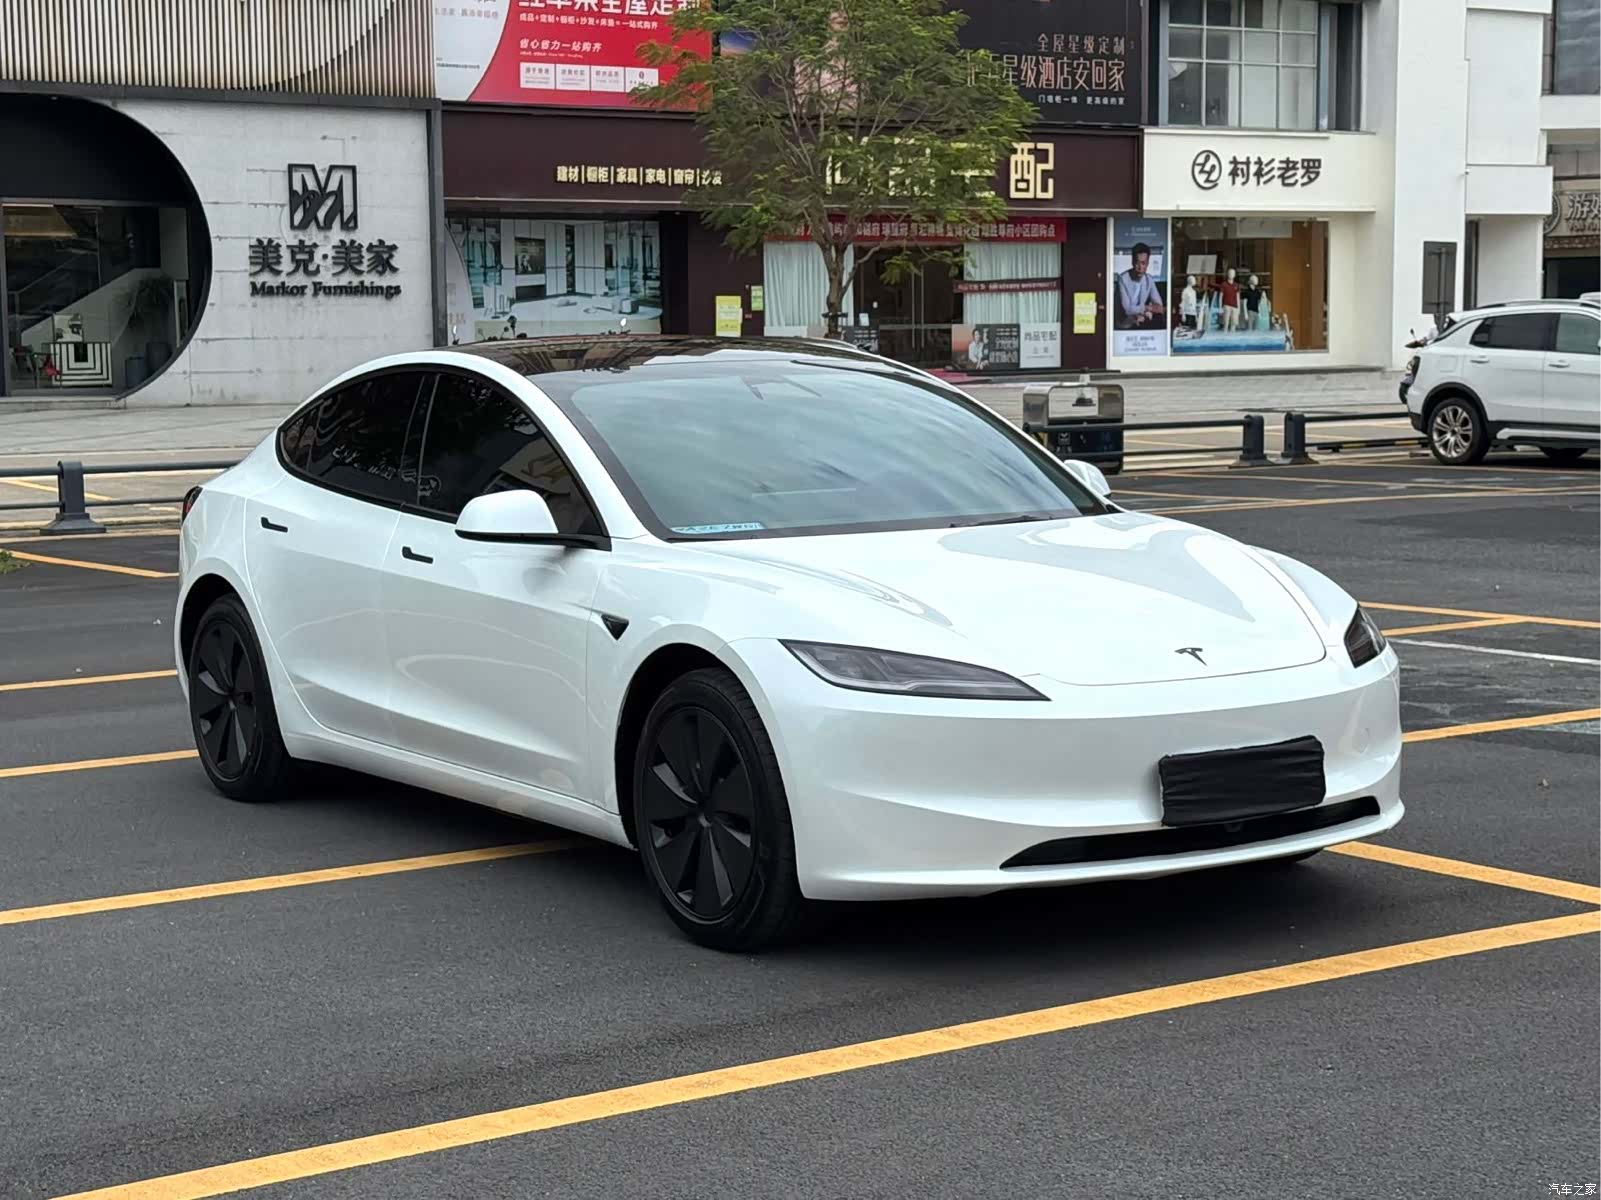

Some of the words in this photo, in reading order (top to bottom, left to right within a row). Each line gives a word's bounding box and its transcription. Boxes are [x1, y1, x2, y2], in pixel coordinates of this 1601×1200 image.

[519, 38, 602, 53] 省心省力一站购齐
[1038, 33, 1125, 55] 全屋星级定制
[1228, 155, 1322, 187] 衬衫老罗
[249, 238, 399, 276] 美克·美家
[250, 281, 307, 297] Markor
[312, 280, 402, 300] Furnishings
